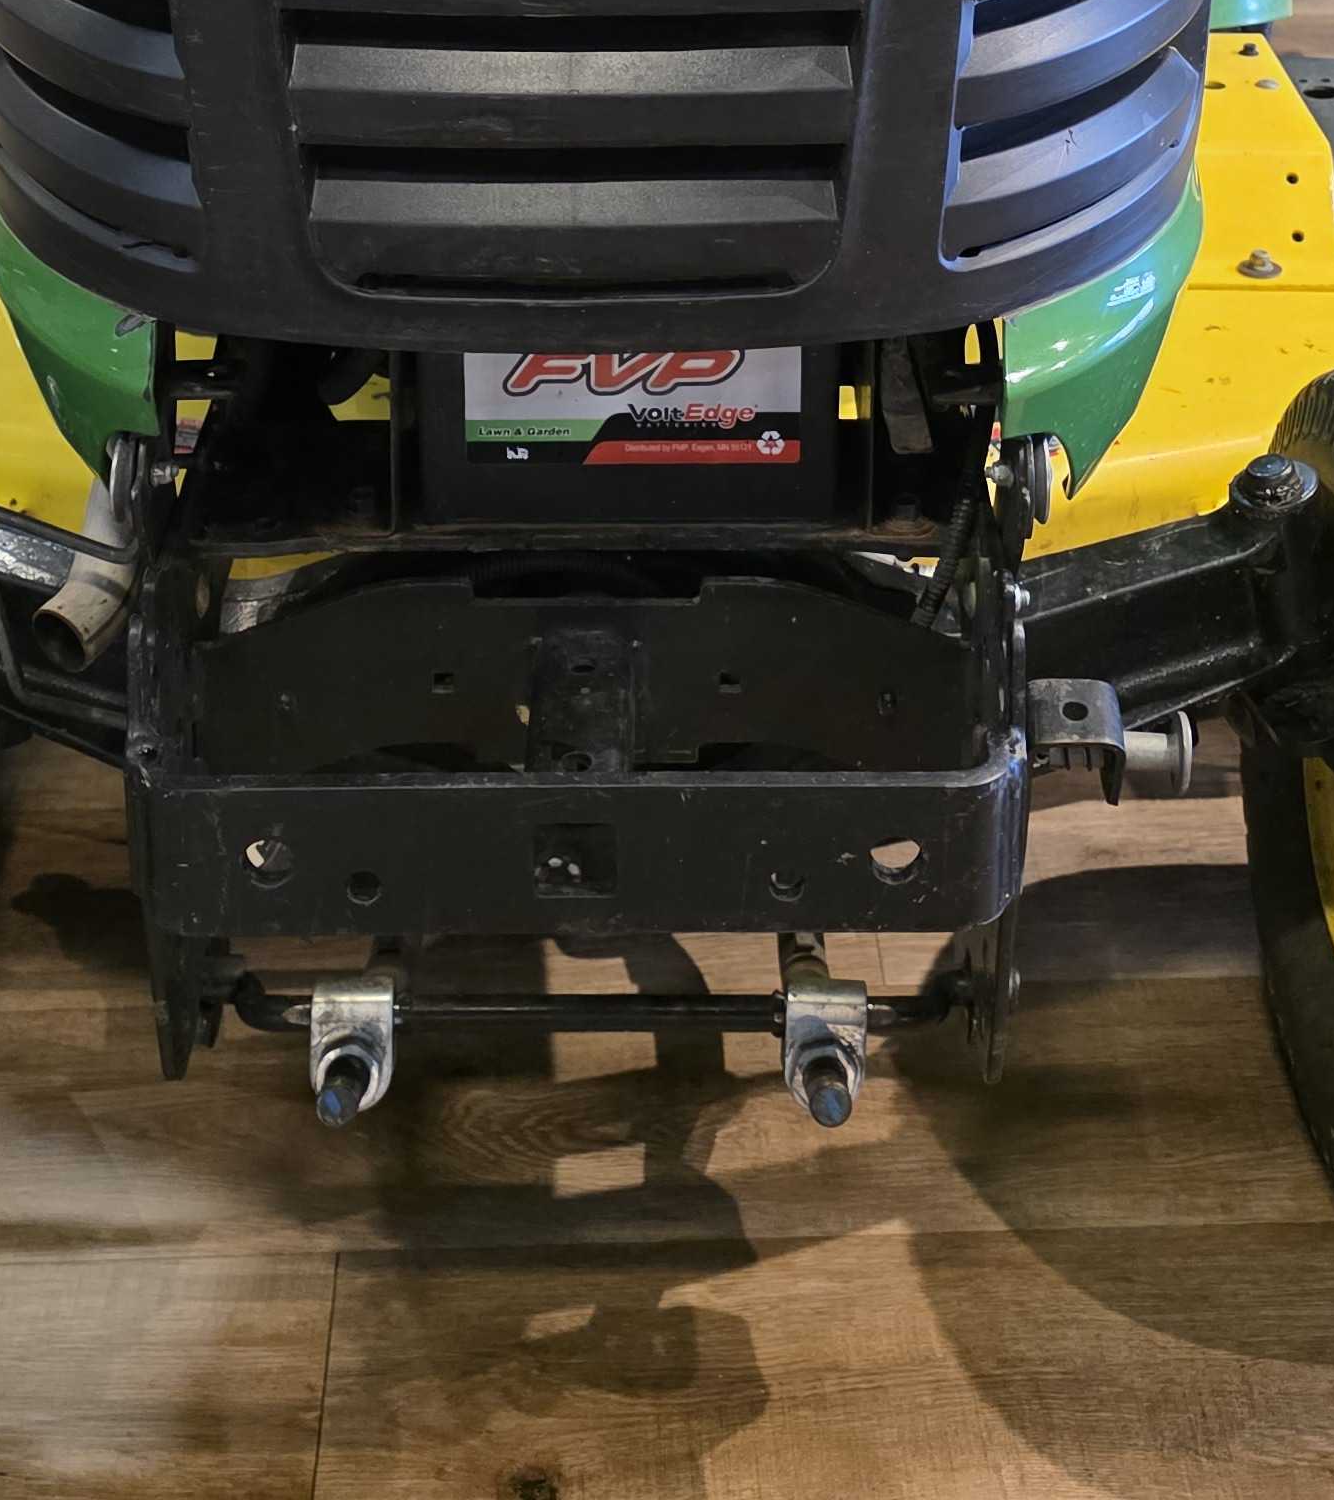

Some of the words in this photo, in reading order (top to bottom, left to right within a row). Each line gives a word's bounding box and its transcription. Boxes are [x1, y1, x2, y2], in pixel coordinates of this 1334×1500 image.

[503, 350, 745, 396] FVP
[478, 426, 510, 436] Lawn
[513, 426, 522, 436] &
[527, 426, 570, 436] Garden
